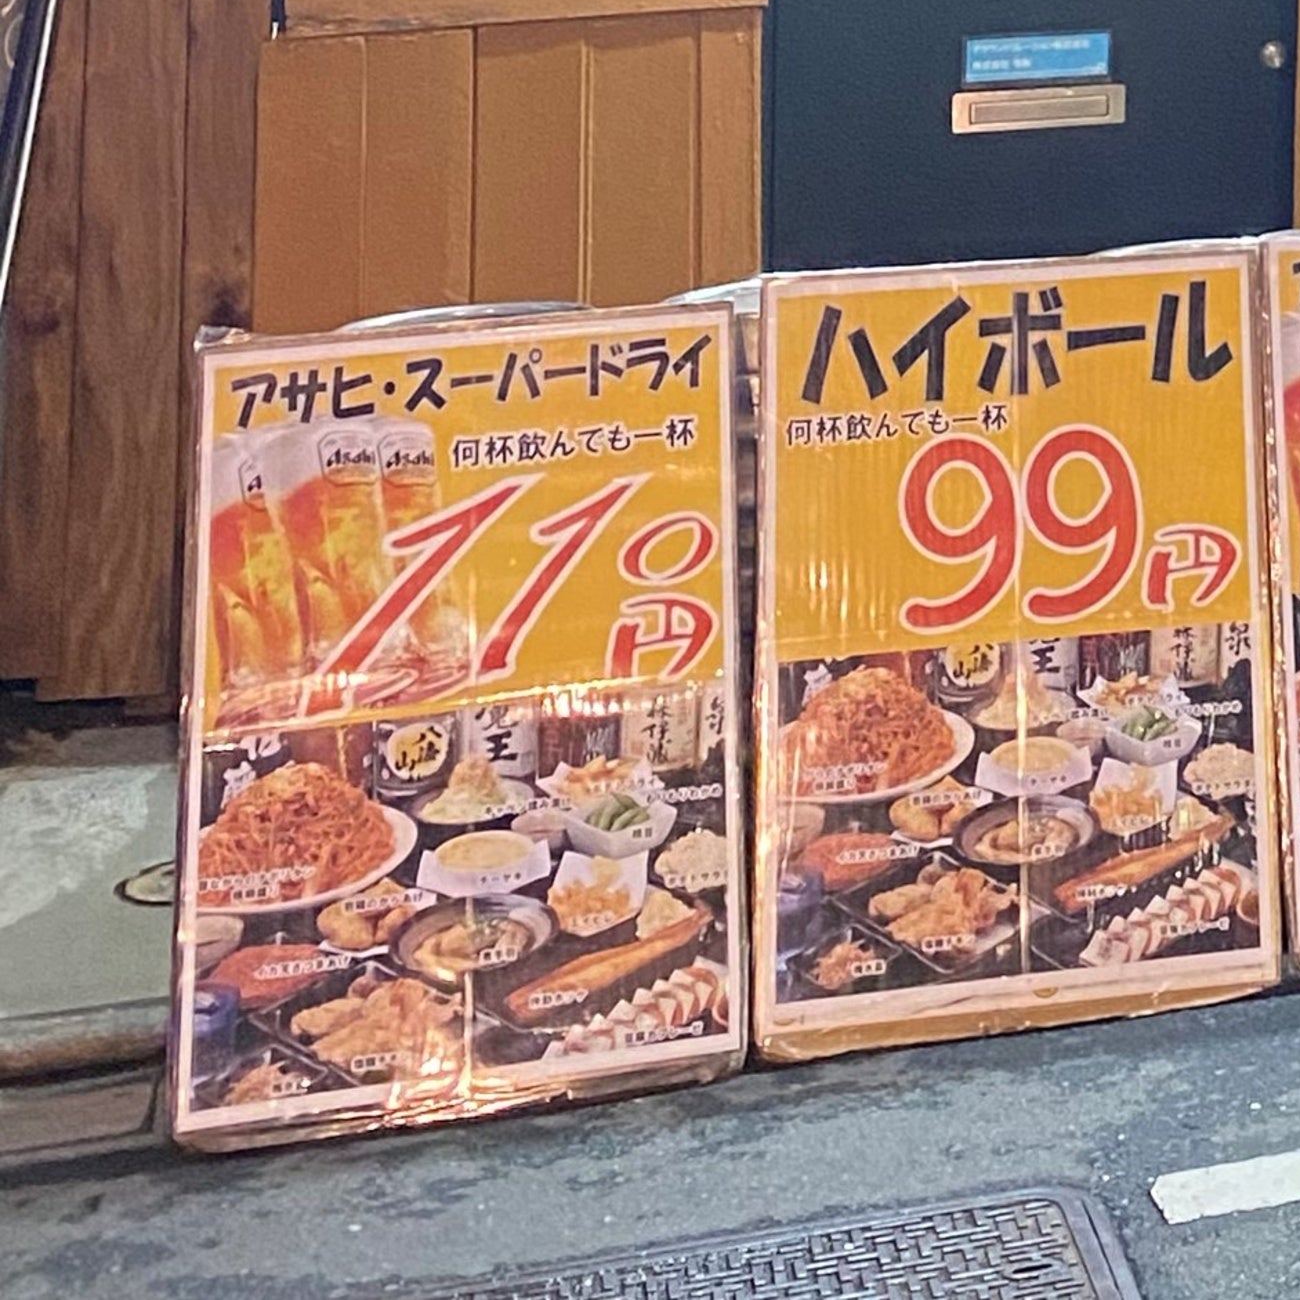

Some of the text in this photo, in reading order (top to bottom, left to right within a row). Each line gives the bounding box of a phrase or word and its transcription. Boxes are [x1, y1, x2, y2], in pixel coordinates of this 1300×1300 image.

[230, 335, 713, 428] アサヒ・スーパードライ
[800, 280, 1233, 405] ハイボール
[452, 418, 696, 469] 何杯飲んでも一杯
[786, 405, 1009, 447] 何杯飲んでも一杯
[899, 426, 1240, 634] 99円
